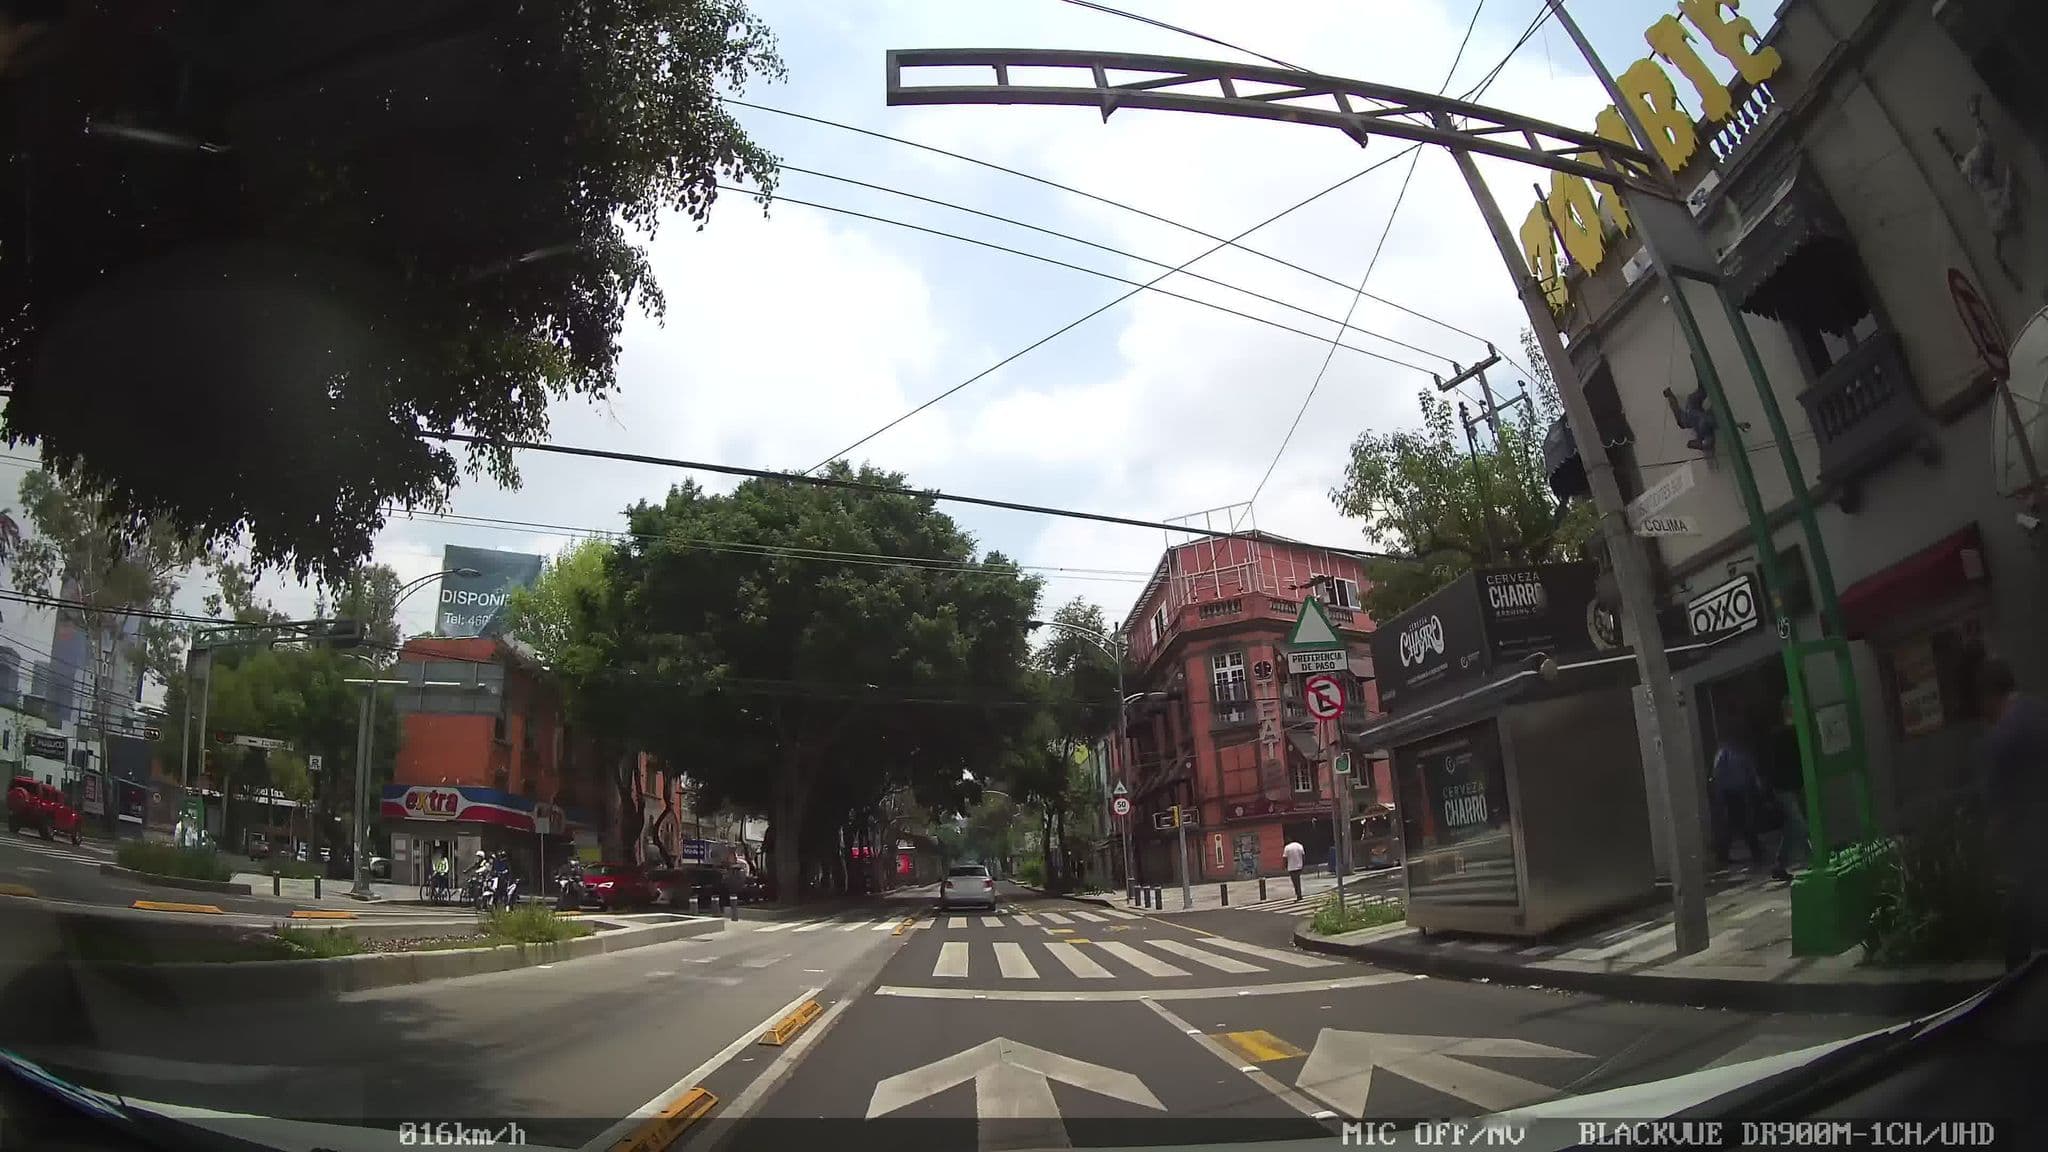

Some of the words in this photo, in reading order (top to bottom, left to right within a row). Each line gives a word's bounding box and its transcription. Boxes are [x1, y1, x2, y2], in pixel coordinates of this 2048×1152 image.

[1644, 519, 1689, 533] COLIMA
[1486, 572, 1540, 585] CERVEZA
[1693, 588, 1752, 633] OXXO
[445, 612, 465, 625] Tel:
[1400, 614, 1445, 668] CHARRO
[1292, 652, 1343, 664] PREFERENCIA
[1302, 663, 1313, 671] DE
[1315, 661, 1336, 671] PASO
[1442, 781, 1486, 799] CERVEZA
[405, 790, 459, 816] extra
[1116, 801, 1127, 809] 50
[1444, 794, 1488, 828] CHARRO
